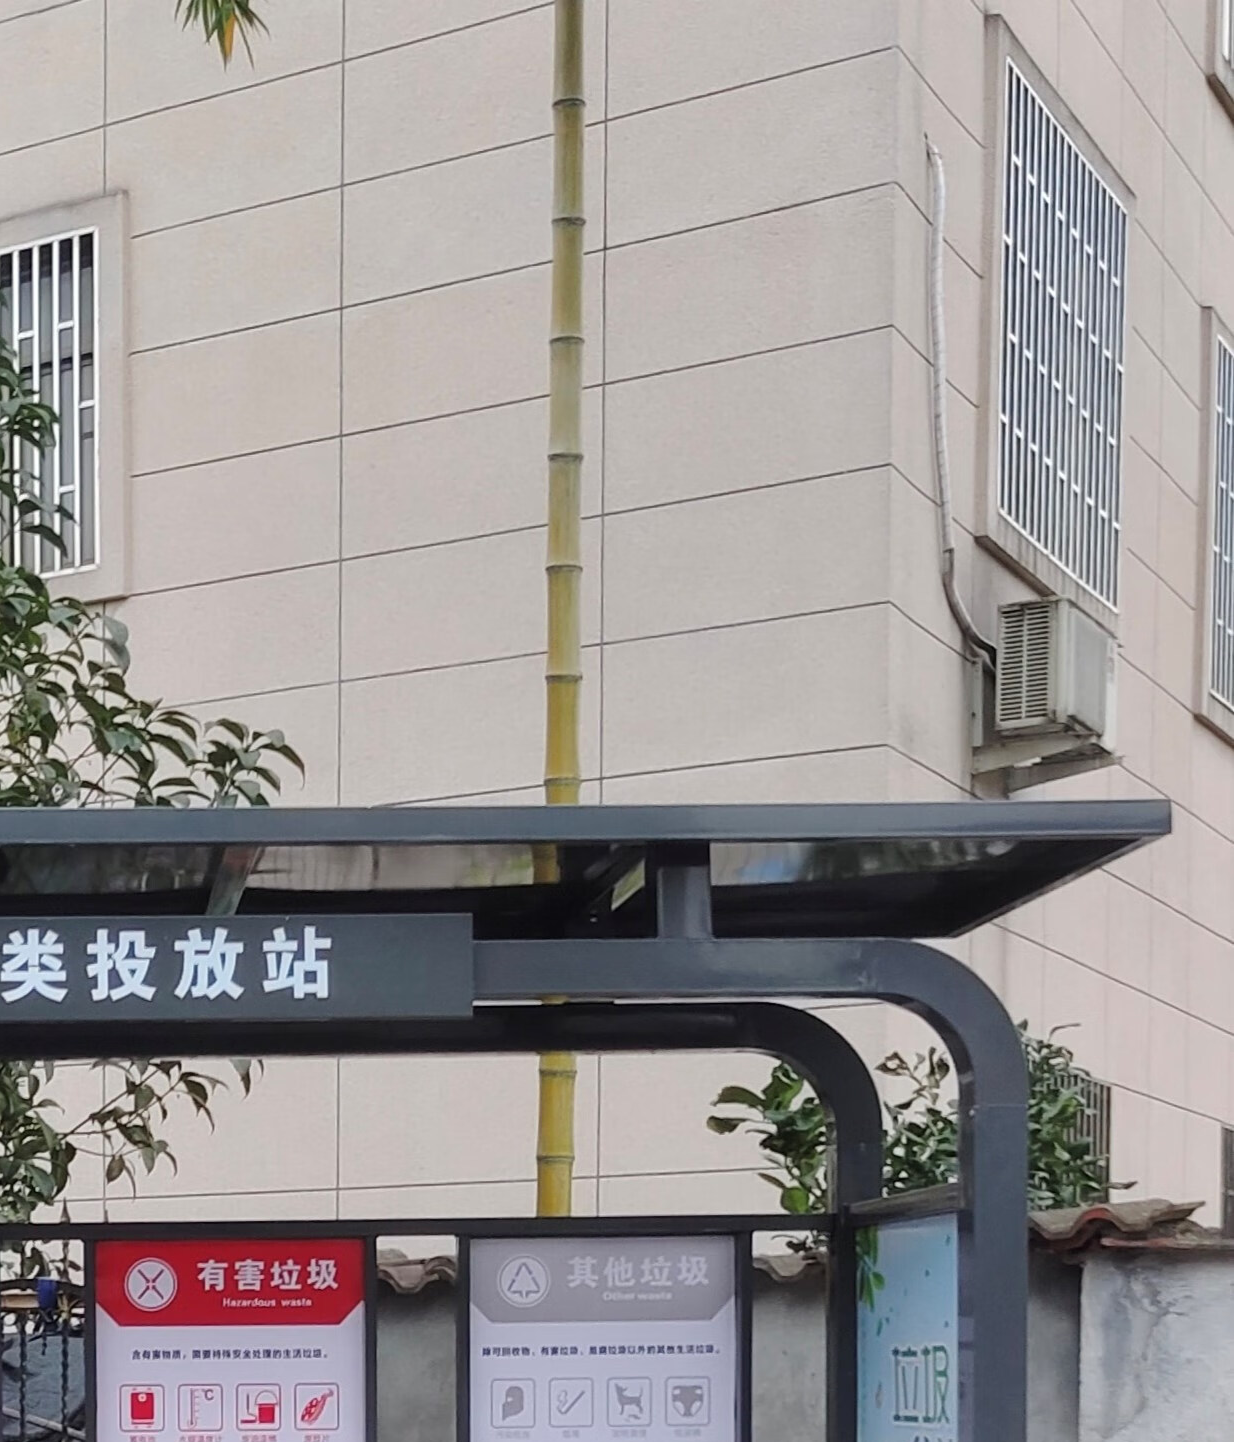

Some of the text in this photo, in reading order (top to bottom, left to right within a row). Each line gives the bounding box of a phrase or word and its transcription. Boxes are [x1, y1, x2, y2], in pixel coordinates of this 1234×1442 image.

[196, 1258, 339, 1292] 有害垃圾
[567, 1255, 710, 1289] 其他垃圾
[222, 1297, 312, 1307] Hazardous waste
